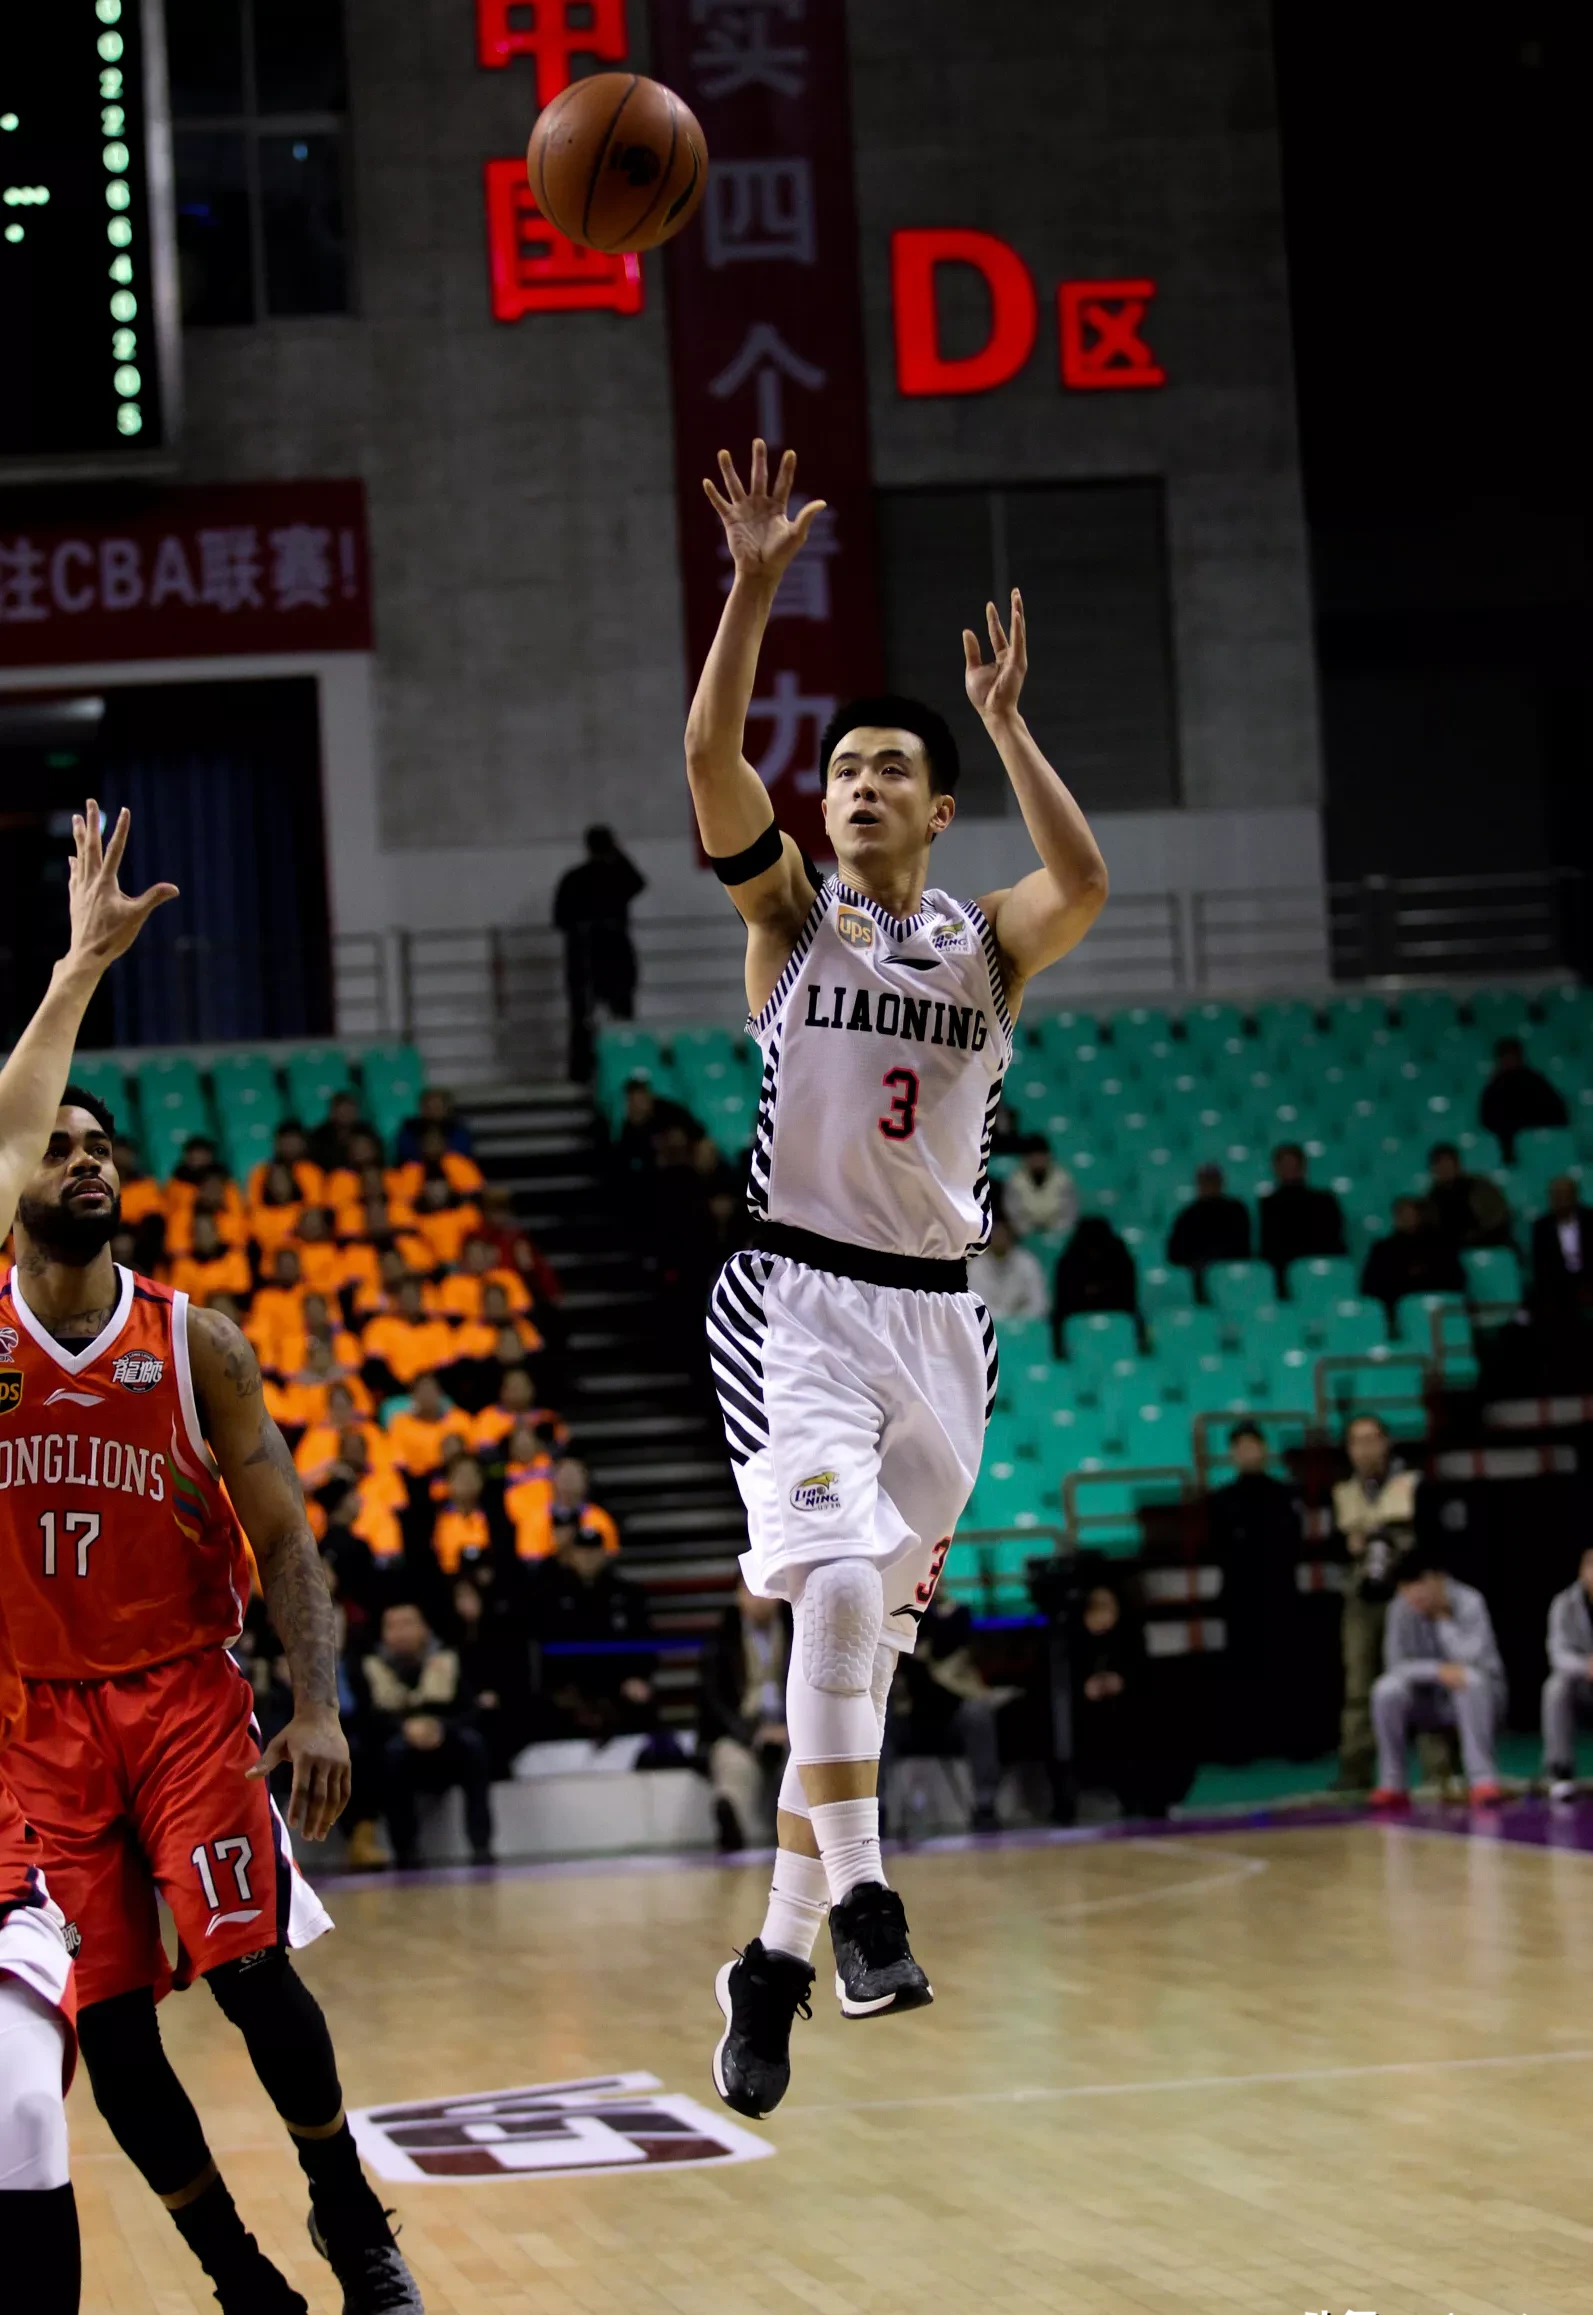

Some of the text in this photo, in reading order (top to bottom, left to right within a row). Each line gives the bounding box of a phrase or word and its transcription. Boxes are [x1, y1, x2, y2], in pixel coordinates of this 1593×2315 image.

[840, 916, 871, 943] ups
[805, 985, 987, 1052] LIAONING
[879, 1067, 920, 1141] 3
[38, 1510, 101, 1577] 17
[914, 1535, 952, 1604] 3
[191, 1835, 252, 1910] 17
